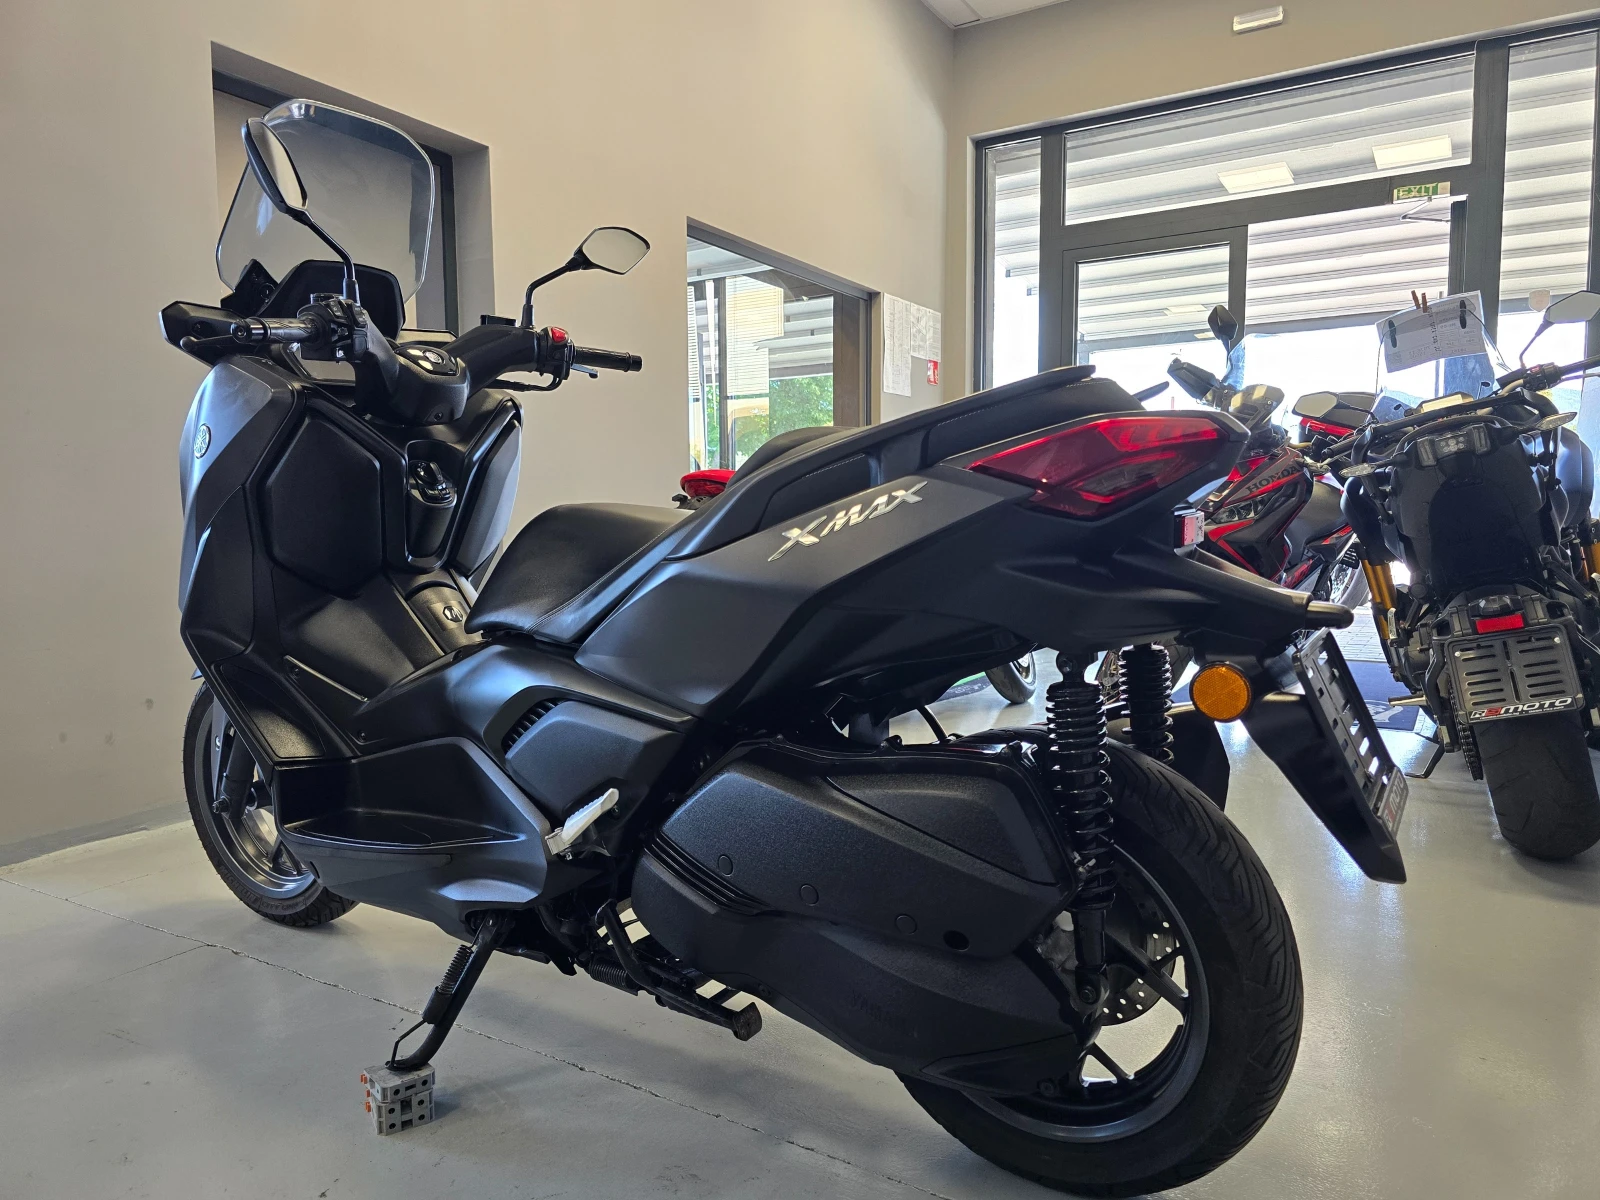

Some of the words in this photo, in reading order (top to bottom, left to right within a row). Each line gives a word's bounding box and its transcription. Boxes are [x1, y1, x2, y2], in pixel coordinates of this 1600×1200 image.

[1398, 182, 1438, 199] EXIT
[1246, 465, 1300, 494] HONDA
[767, 480, 928, 562] XMAX
